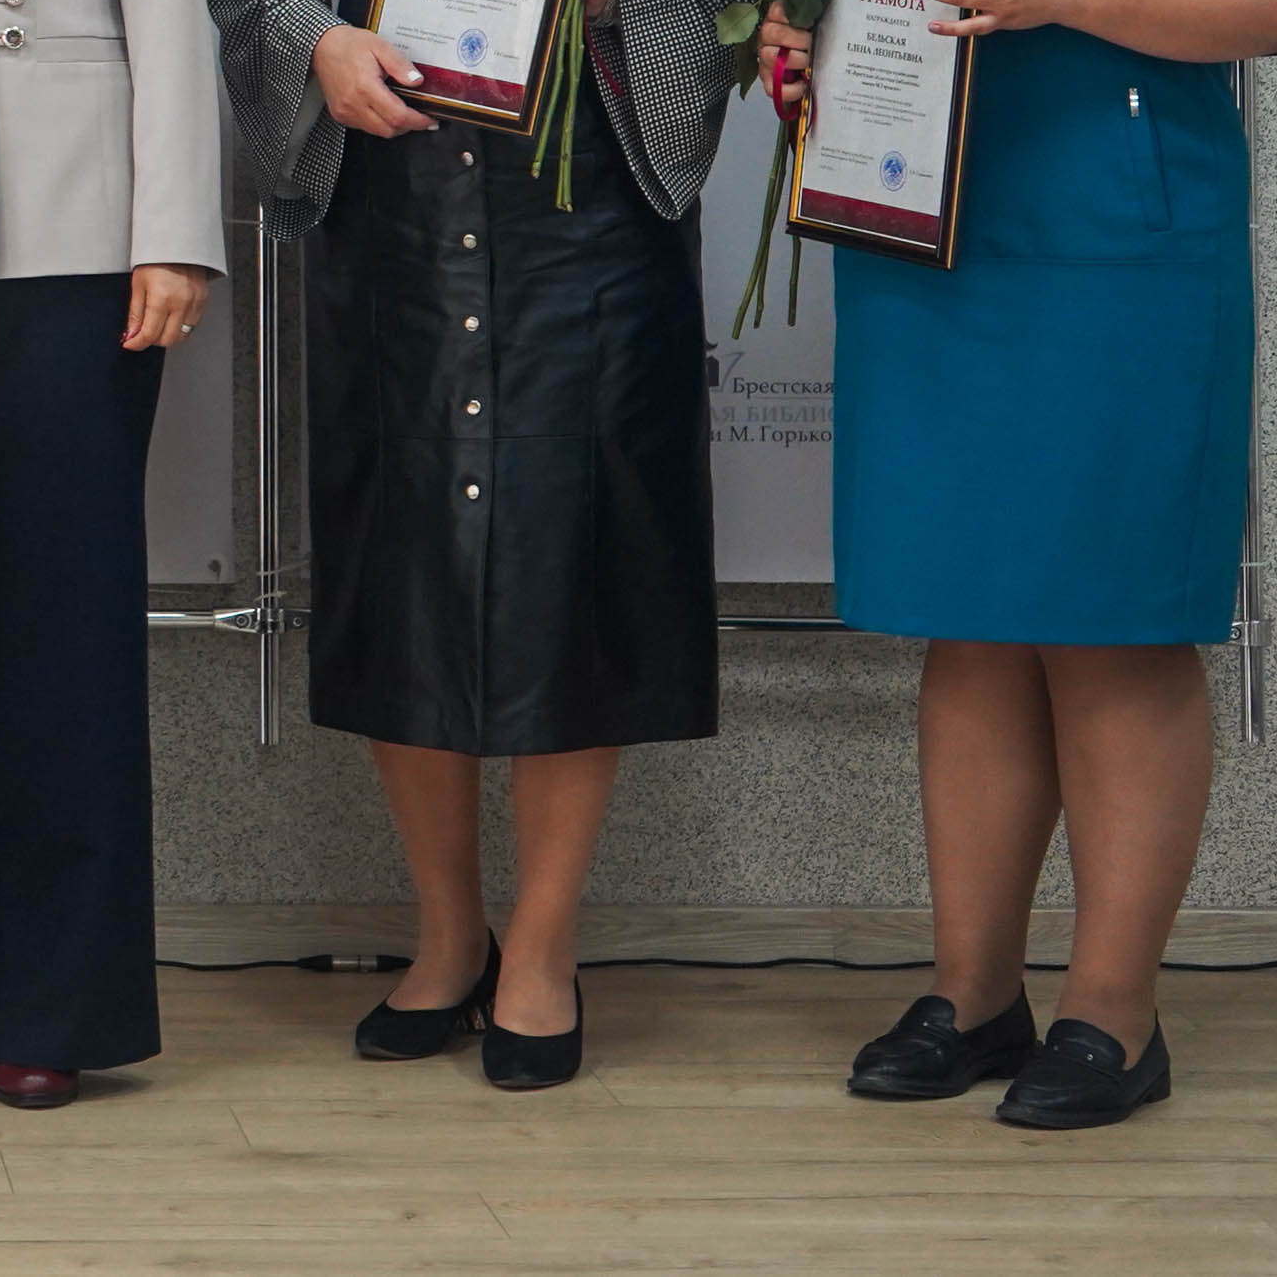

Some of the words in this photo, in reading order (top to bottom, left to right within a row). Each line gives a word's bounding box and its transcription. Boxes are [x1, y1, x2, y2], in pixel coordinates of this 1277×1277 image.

[867, 33, 906, 46] БЕЛЬСКАЯ
[847, 43, 871, 55] ЕЛЕНА
[733, 378, 834, 399] Брестская
[761, 426, 832, 447] Горько
